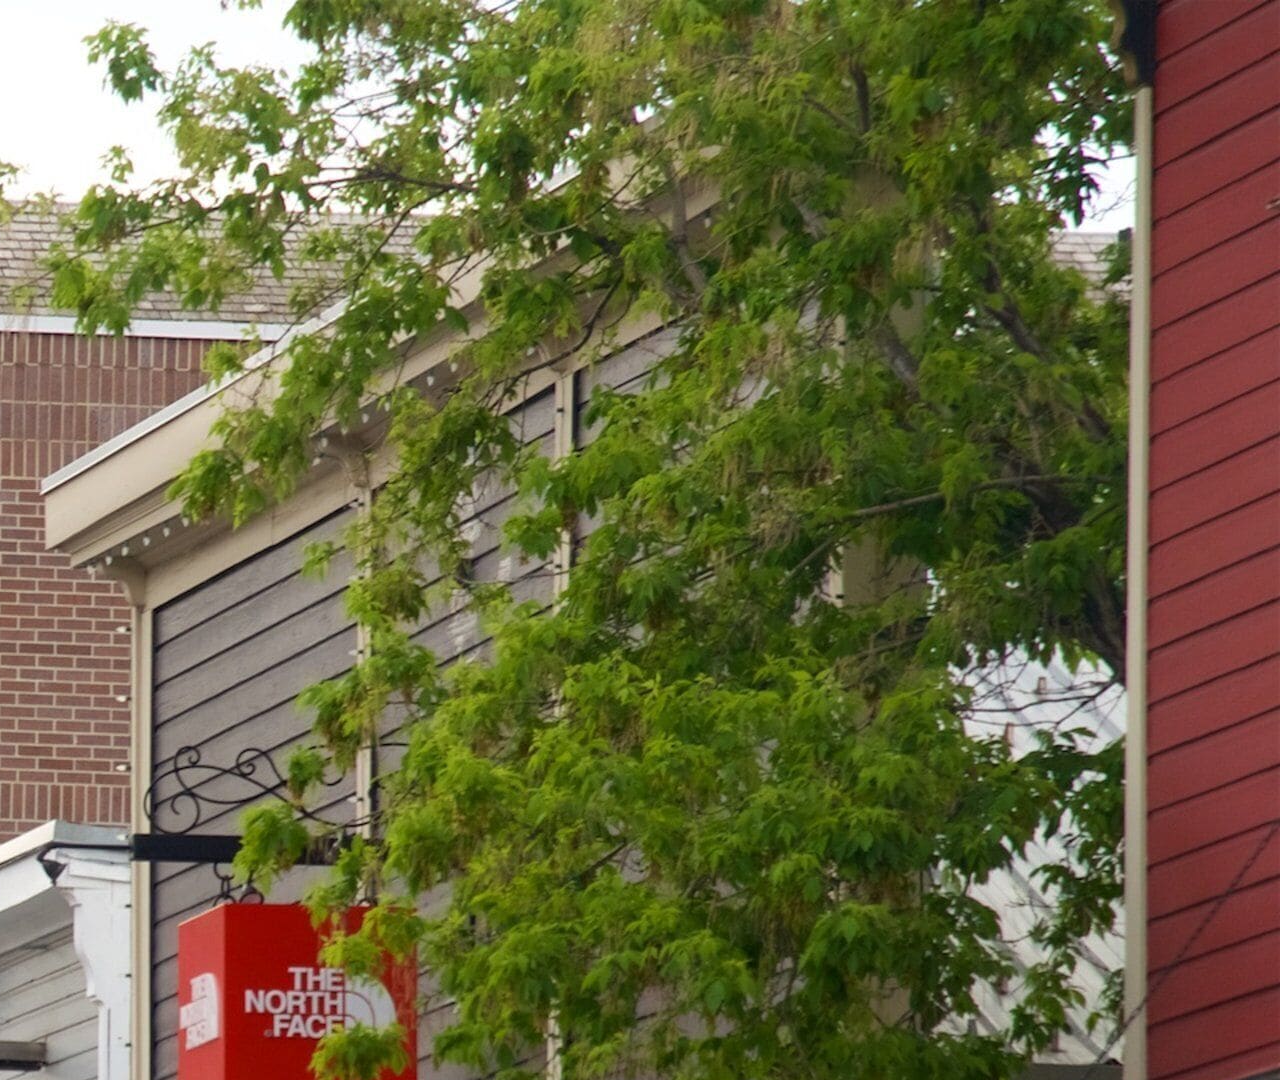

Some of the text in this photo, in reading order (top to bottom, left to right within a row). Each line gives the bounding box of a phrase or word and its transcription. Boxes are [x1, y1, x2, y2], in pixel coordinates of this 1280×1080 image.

[288, 967, 344, 991] THE
[244, 990, 344, 1015] NORTH
[273, 1016, 346, 1039] FACE
